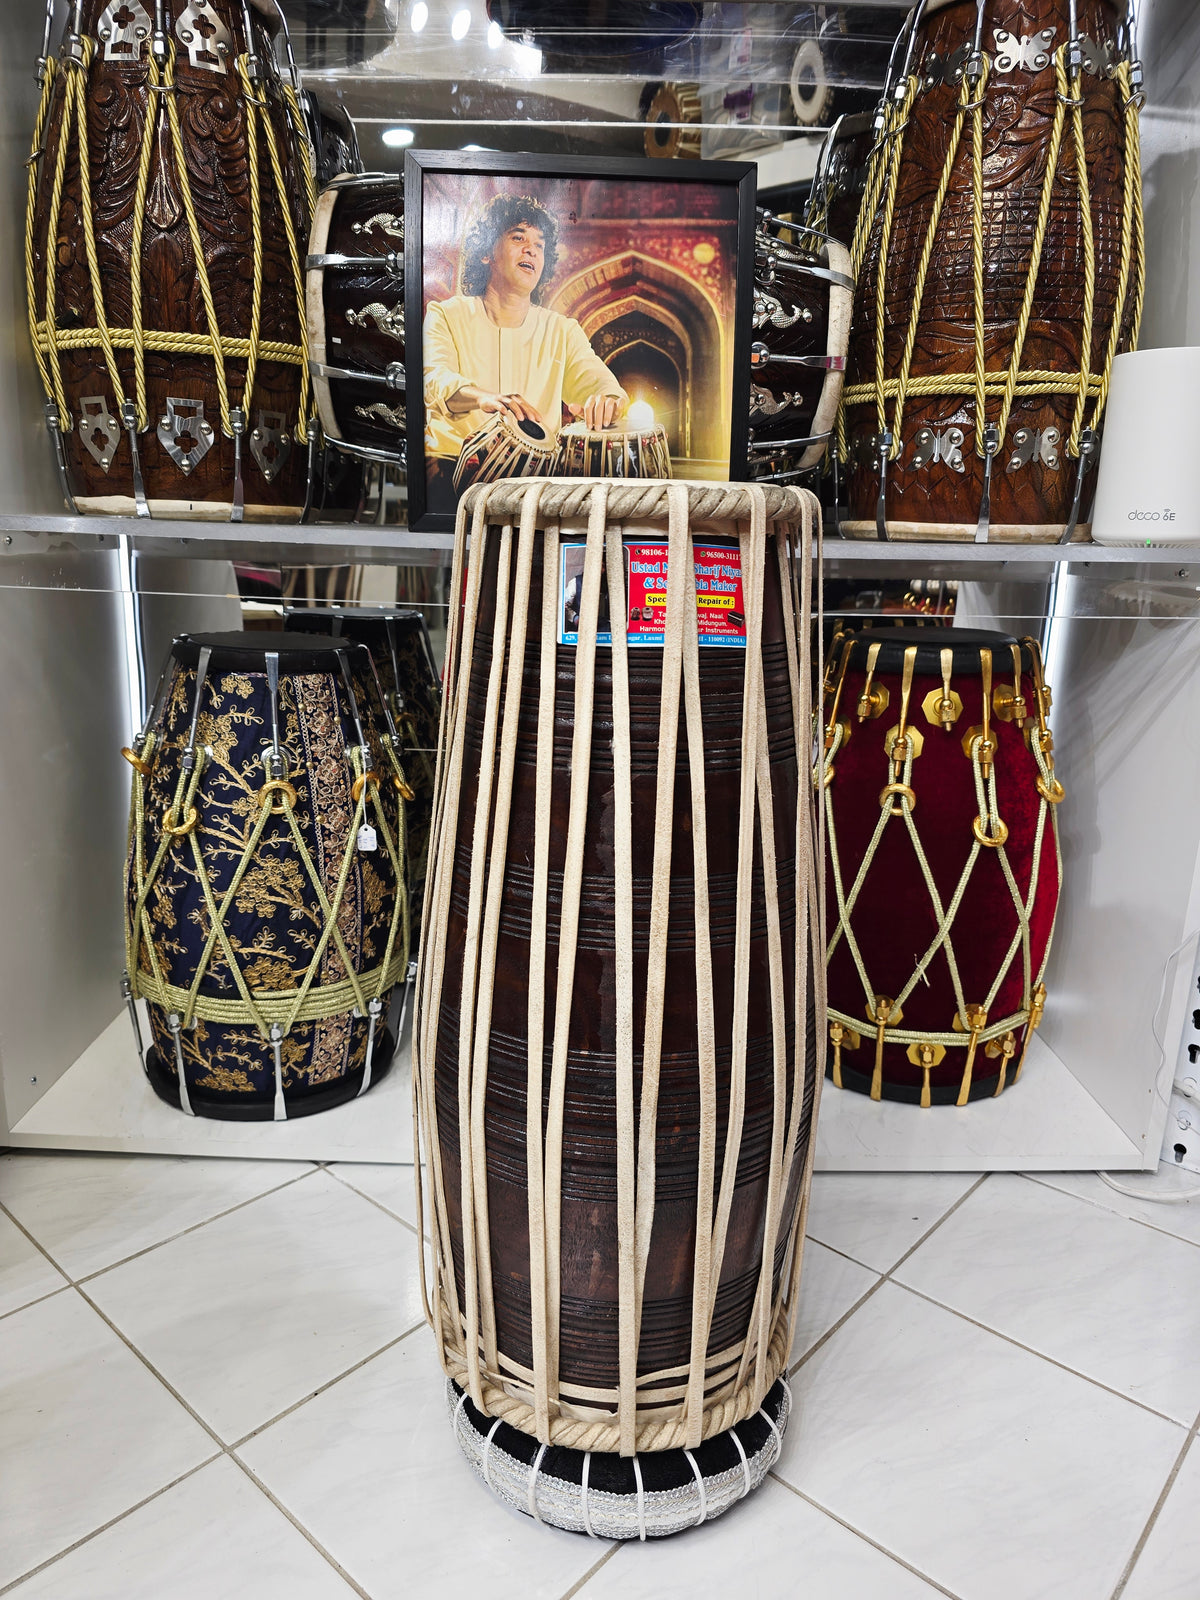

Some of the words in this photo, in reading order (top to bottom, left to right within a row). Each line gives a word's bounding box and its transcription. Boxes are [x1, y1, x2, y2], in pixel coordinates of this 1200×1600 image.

[631, 561, 660, 573] Ustad
[694, 563, 720, 578] Sharif
[721, 565, 742, 579] Niya
[643, 577, 655, 589] &
[710, 579, 737, 592] Maker
[647, 595, 667, 604] Spec
[698, 597, 722, 606] Repair
[705, 627, 739, 635] Instruments
